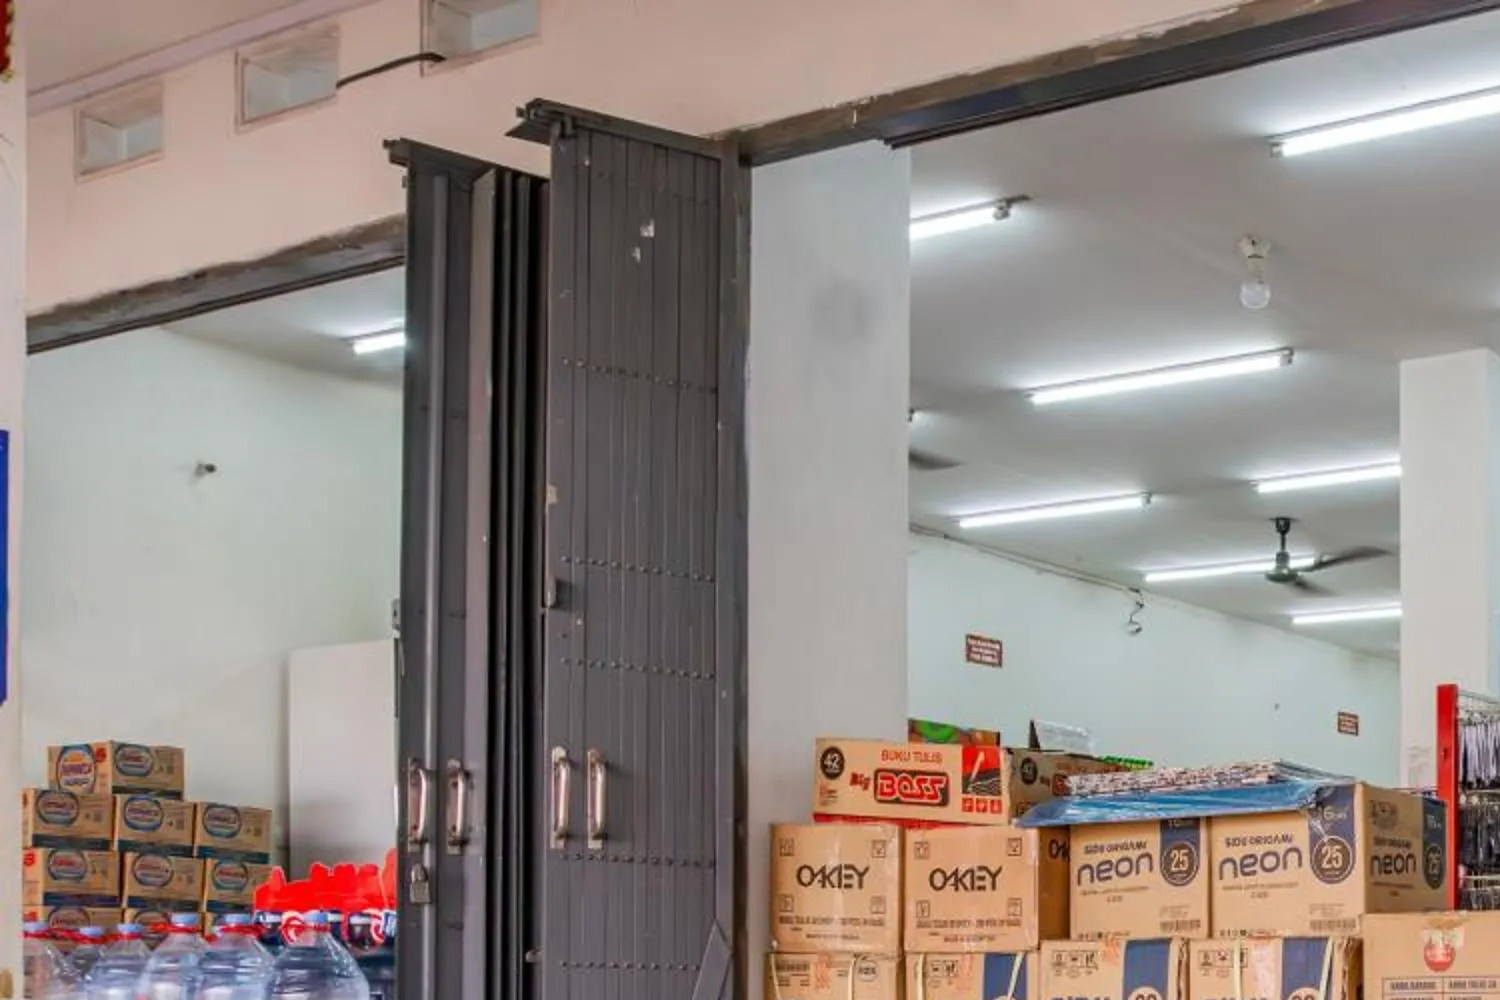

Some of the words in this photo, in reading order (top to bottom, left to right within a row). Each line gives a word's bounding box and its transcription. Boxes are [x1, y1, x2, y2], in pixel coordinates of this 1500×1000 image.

[1077, 852, 1153, 886] neon
[1171, 849, 1189, 872] 25
[1219, 847, 1302, 880] neon
[1320, 845, 1343, 869] 25
[1370, 853, 1417, 877] neon
